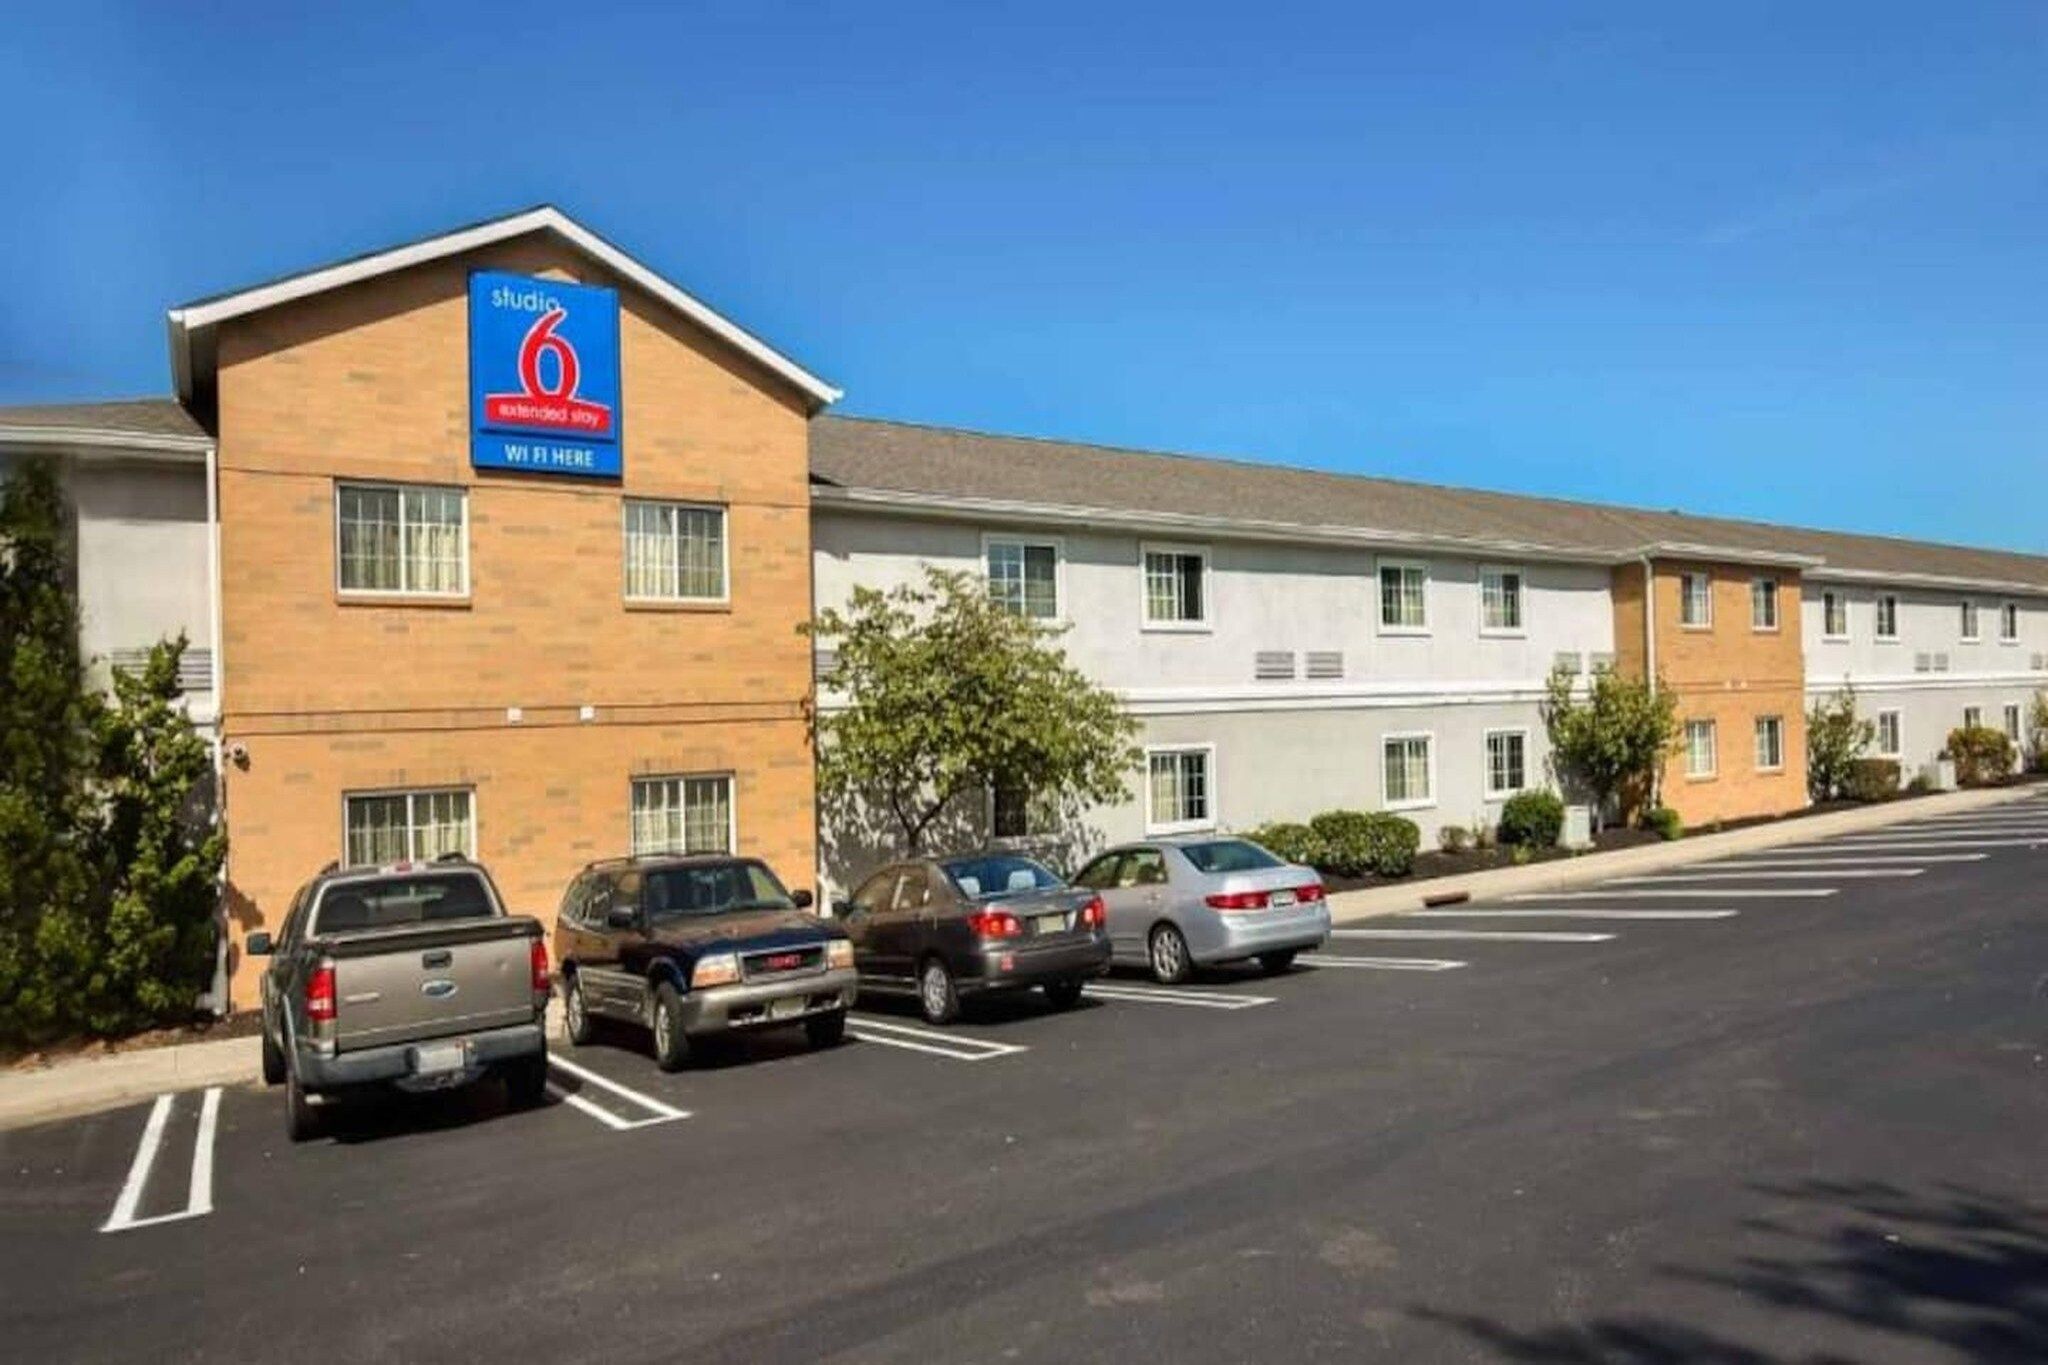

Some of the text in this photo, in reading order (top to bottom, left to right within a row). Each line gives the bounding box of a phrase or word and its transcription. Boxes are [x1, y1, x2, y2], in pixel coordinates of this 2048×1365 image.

[492, 286, 560, 312] studio
[518, 308, 580, 400] 6
[499, 403, 599, 429] extended stay
[504, 444, 594, 467] WI FI HERE
